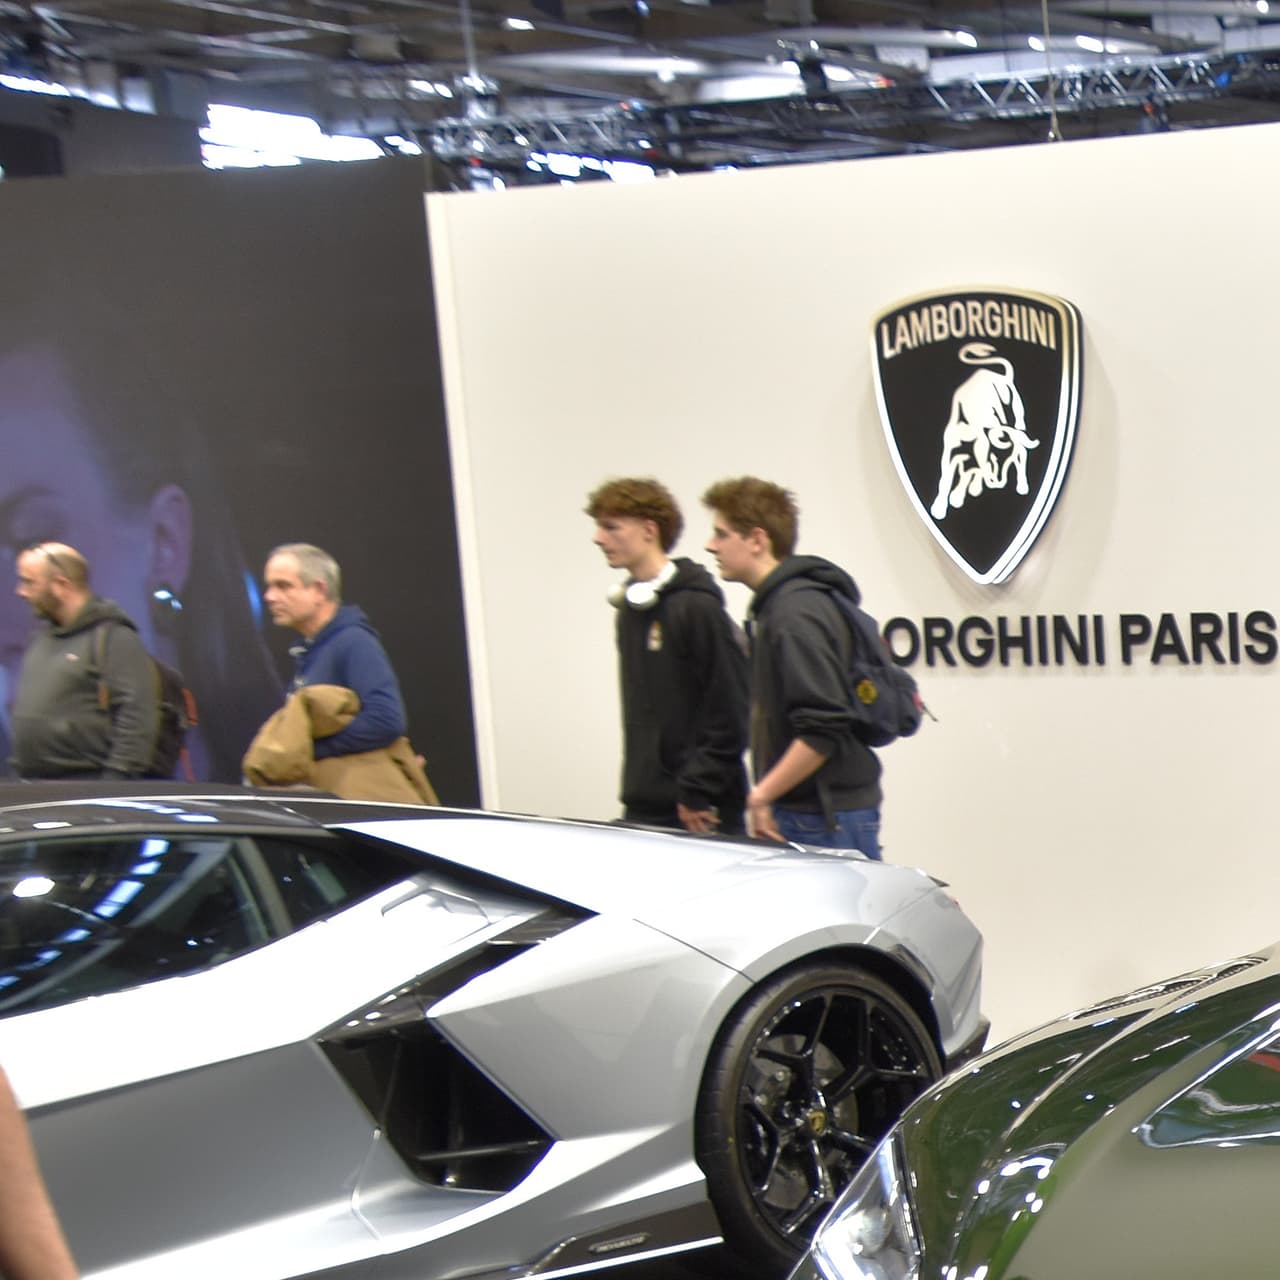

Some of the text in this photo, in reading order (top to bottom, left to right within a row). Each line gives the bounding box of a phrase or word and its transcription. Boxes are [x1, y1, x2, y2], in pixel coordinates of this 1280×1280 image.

[881, 300, 1057, 358] LAMBORGHINI
[882, 611, 1278, 667] ORGHINI PARIS
